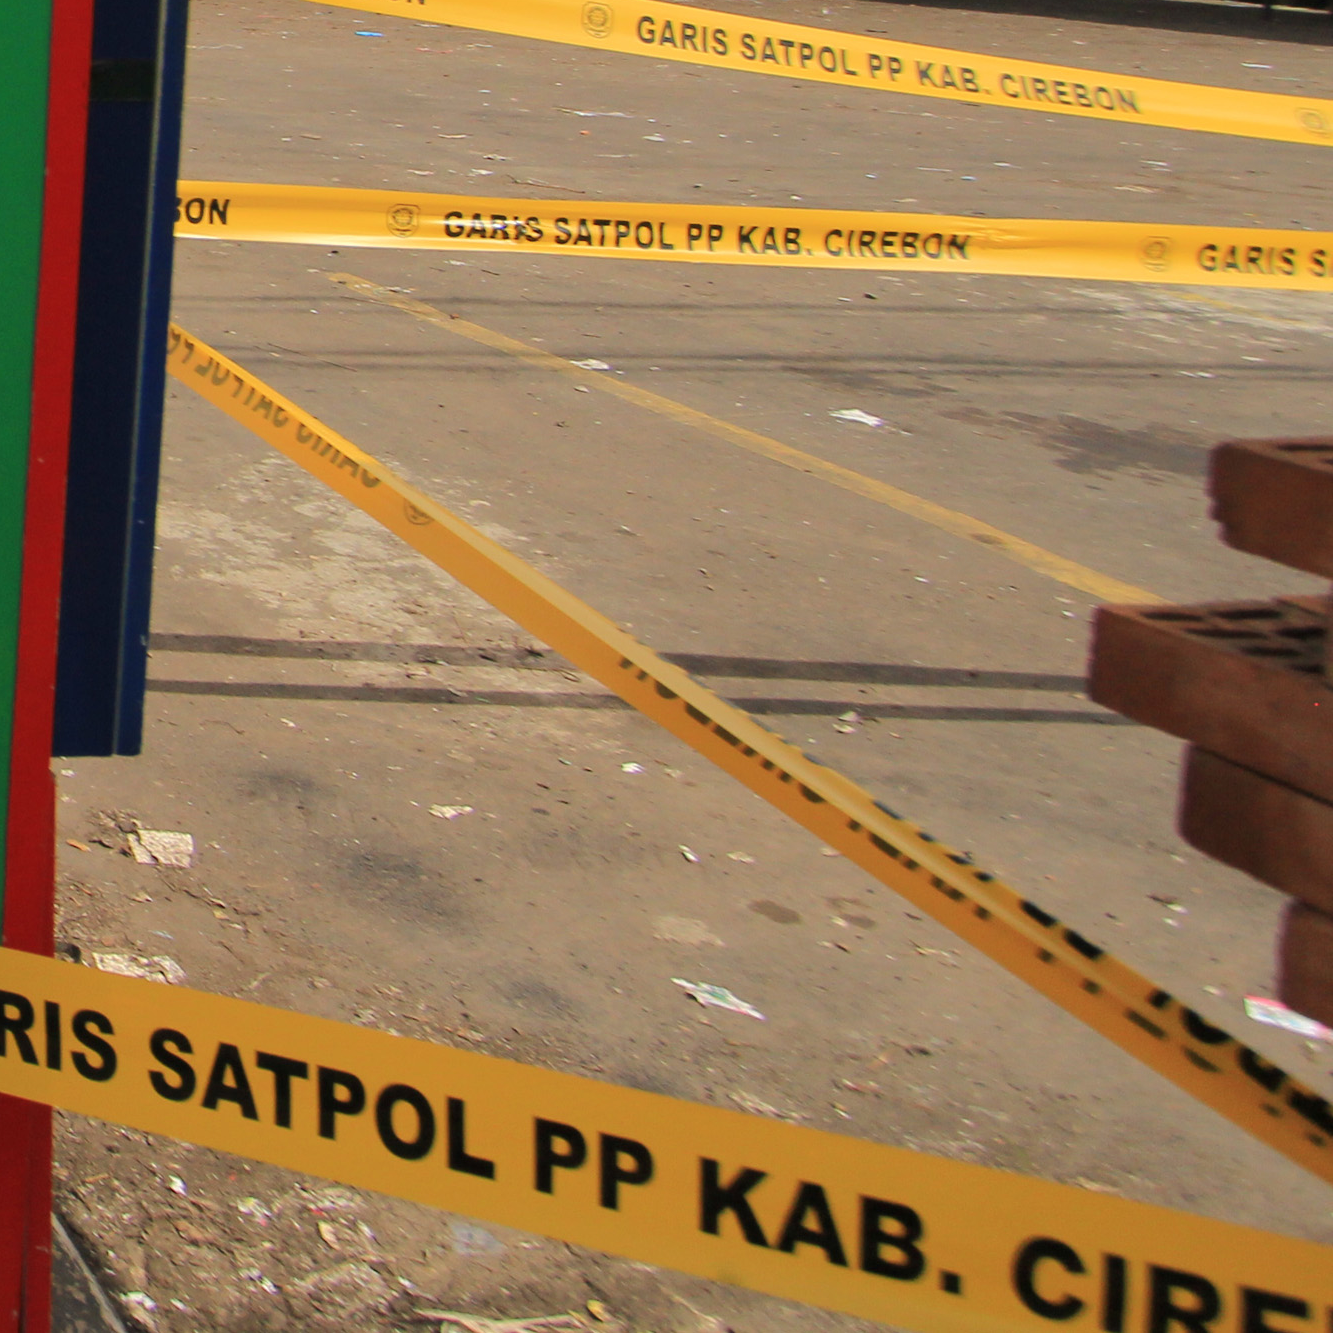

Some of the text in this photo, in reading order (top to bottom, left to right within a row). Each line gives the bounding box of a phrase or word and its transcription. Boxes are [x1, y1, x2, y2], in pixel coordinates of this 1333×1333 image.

[636, 15, 1142, 114] GARIS SATPOL PP KAB. CIREBON
[444, 210, 972, 260] GARIS SATPOL PP KAB. CIREBON
[1197, 244, 1333, 277] GARIS S
[148, 1027, 497, 1181] SATPOL
[533, 1115, 655, 1212] PP
[697, 1155, 963, 1297] KAB.
[1011, 1234, 1333, 1333] CIRE
